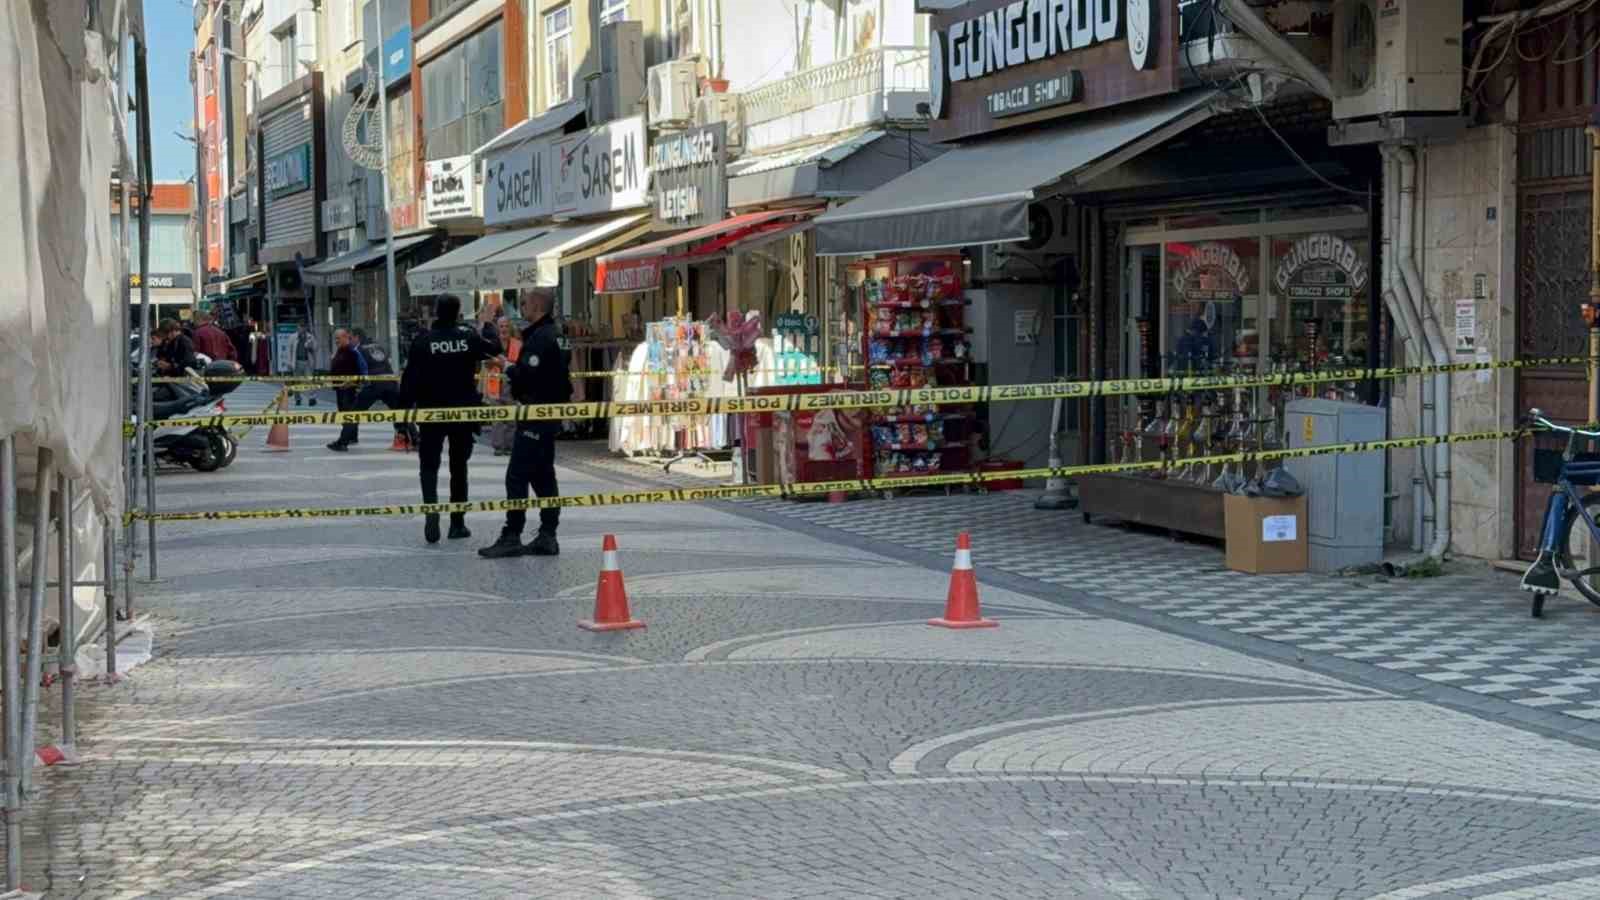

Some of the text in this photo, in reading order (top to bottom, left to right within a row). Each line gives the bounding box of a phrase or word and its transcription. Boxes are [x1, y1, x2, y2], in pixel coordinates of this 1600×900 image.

[986, 86, 1029, 112] TOBACCO
[1034, 79, 1060, 104] SHOP
[496, 152, 542, 212] SAREM
[581, 131, 638, 199] SAREM
